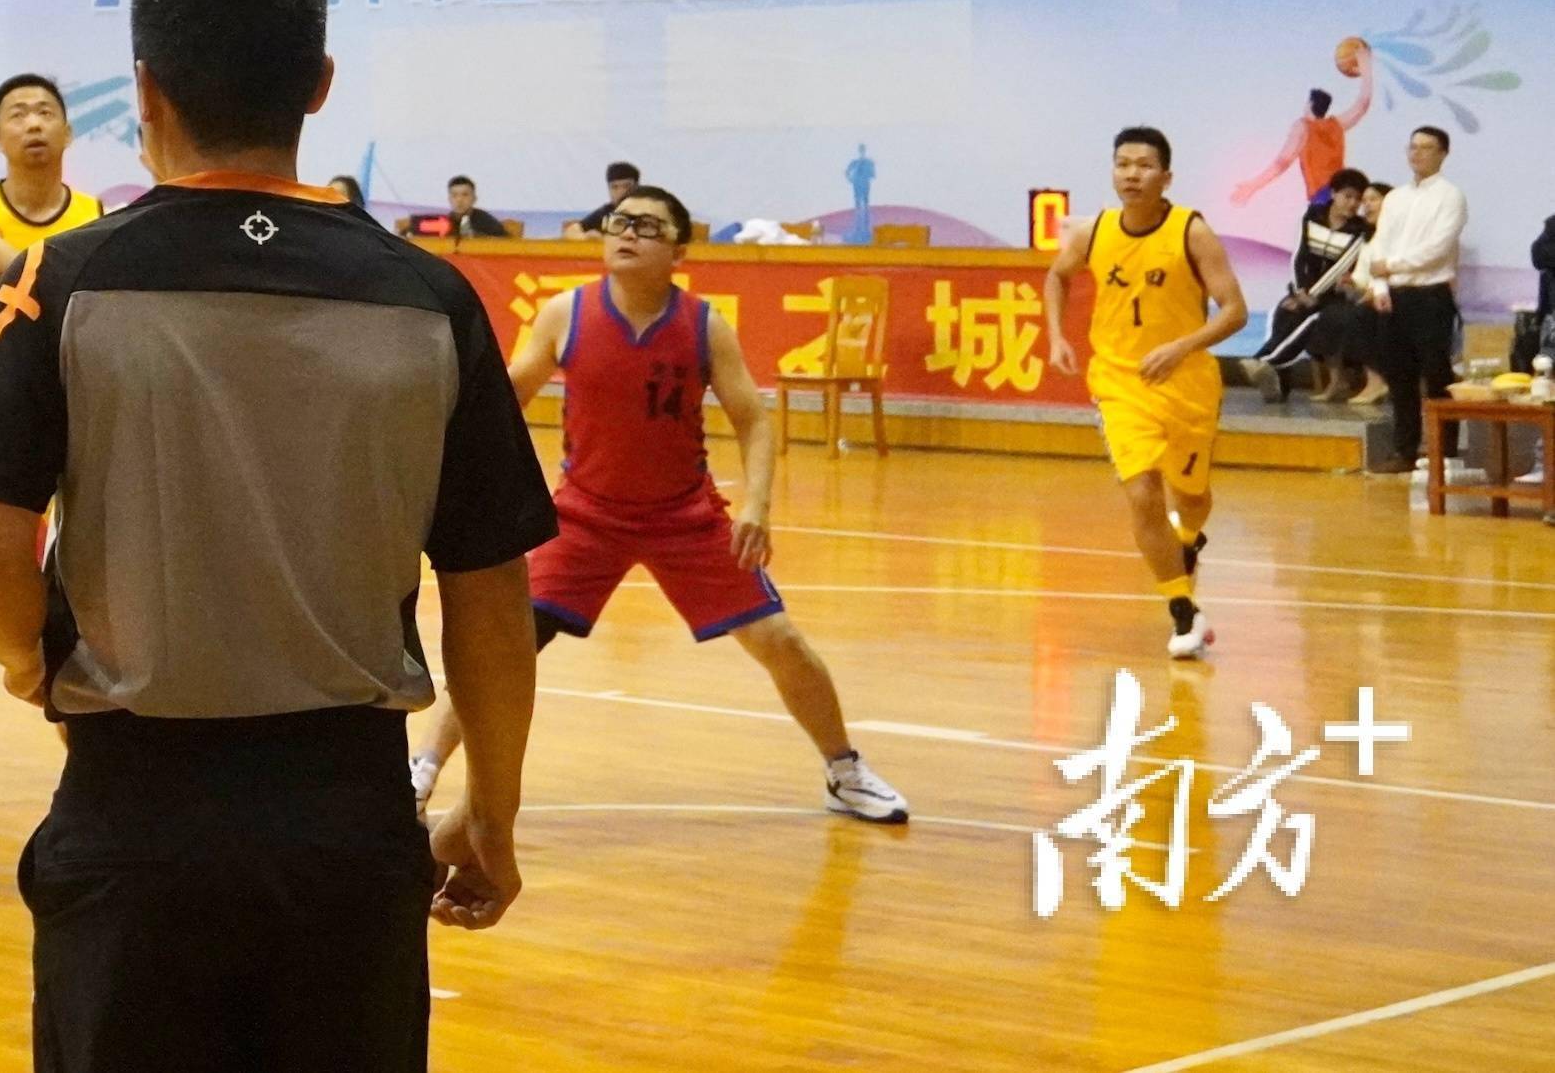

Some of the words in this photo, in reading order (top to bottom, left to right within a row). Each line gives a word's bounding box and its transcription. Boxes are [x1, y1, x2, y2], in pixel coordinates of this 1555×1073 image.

[1131, 296, 1143, 327] 1
[644, 381, 682, 422] 14
[1181, 452, 1198, 477] 1
